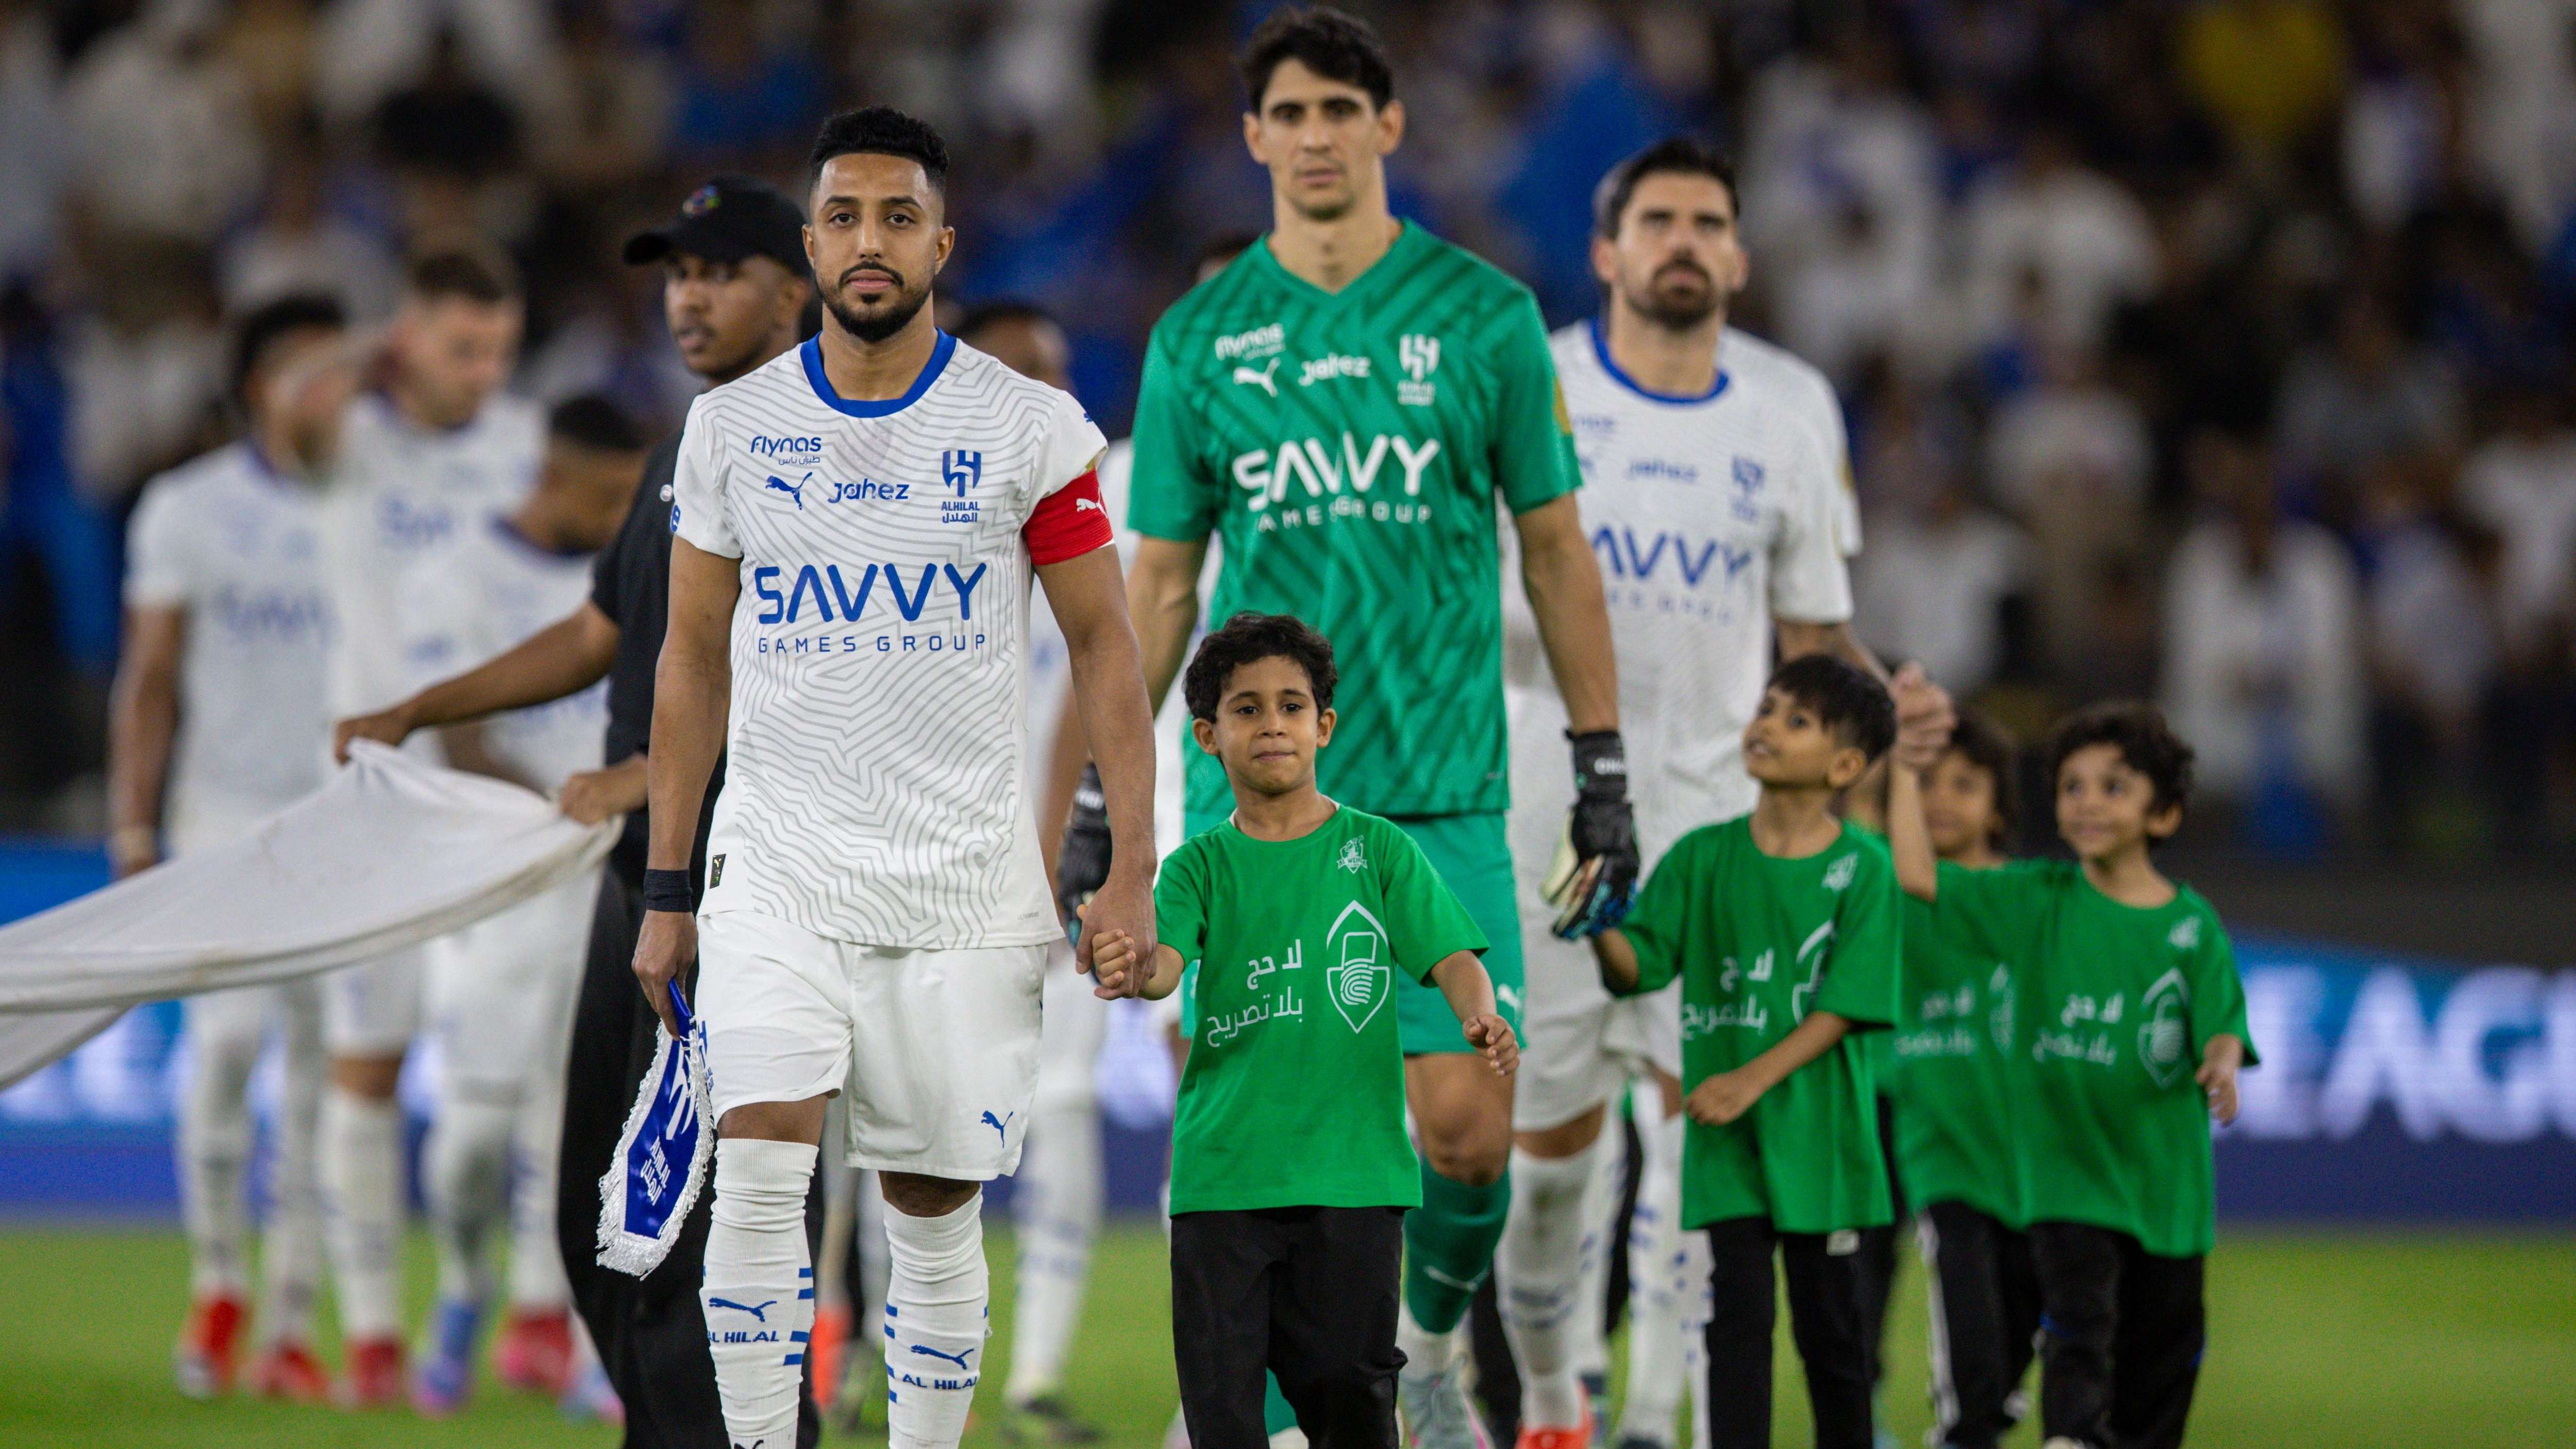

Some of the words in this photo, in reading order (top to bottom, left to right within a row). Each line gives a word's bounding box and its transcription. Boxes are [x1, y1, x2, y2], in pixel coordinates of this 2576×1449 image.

[750, 436, 821, 457] flynas
[827, 478, 909, 503] jahez
[941, 501, 980, 511] ALHILAL
[1591, 522, 1753, 589] AVVY
[755, 563, 987, 624] SAVVY
[759, 636, 856, 653] GAMES
[877, 634, 986, 652] GROUP
[1282, 938, 1302, 970] لا
[1247, 956, 1275, 990] حج
[724, 1331, 779, 1343] HILAL
[902, 1374, 927, 1388] AL
